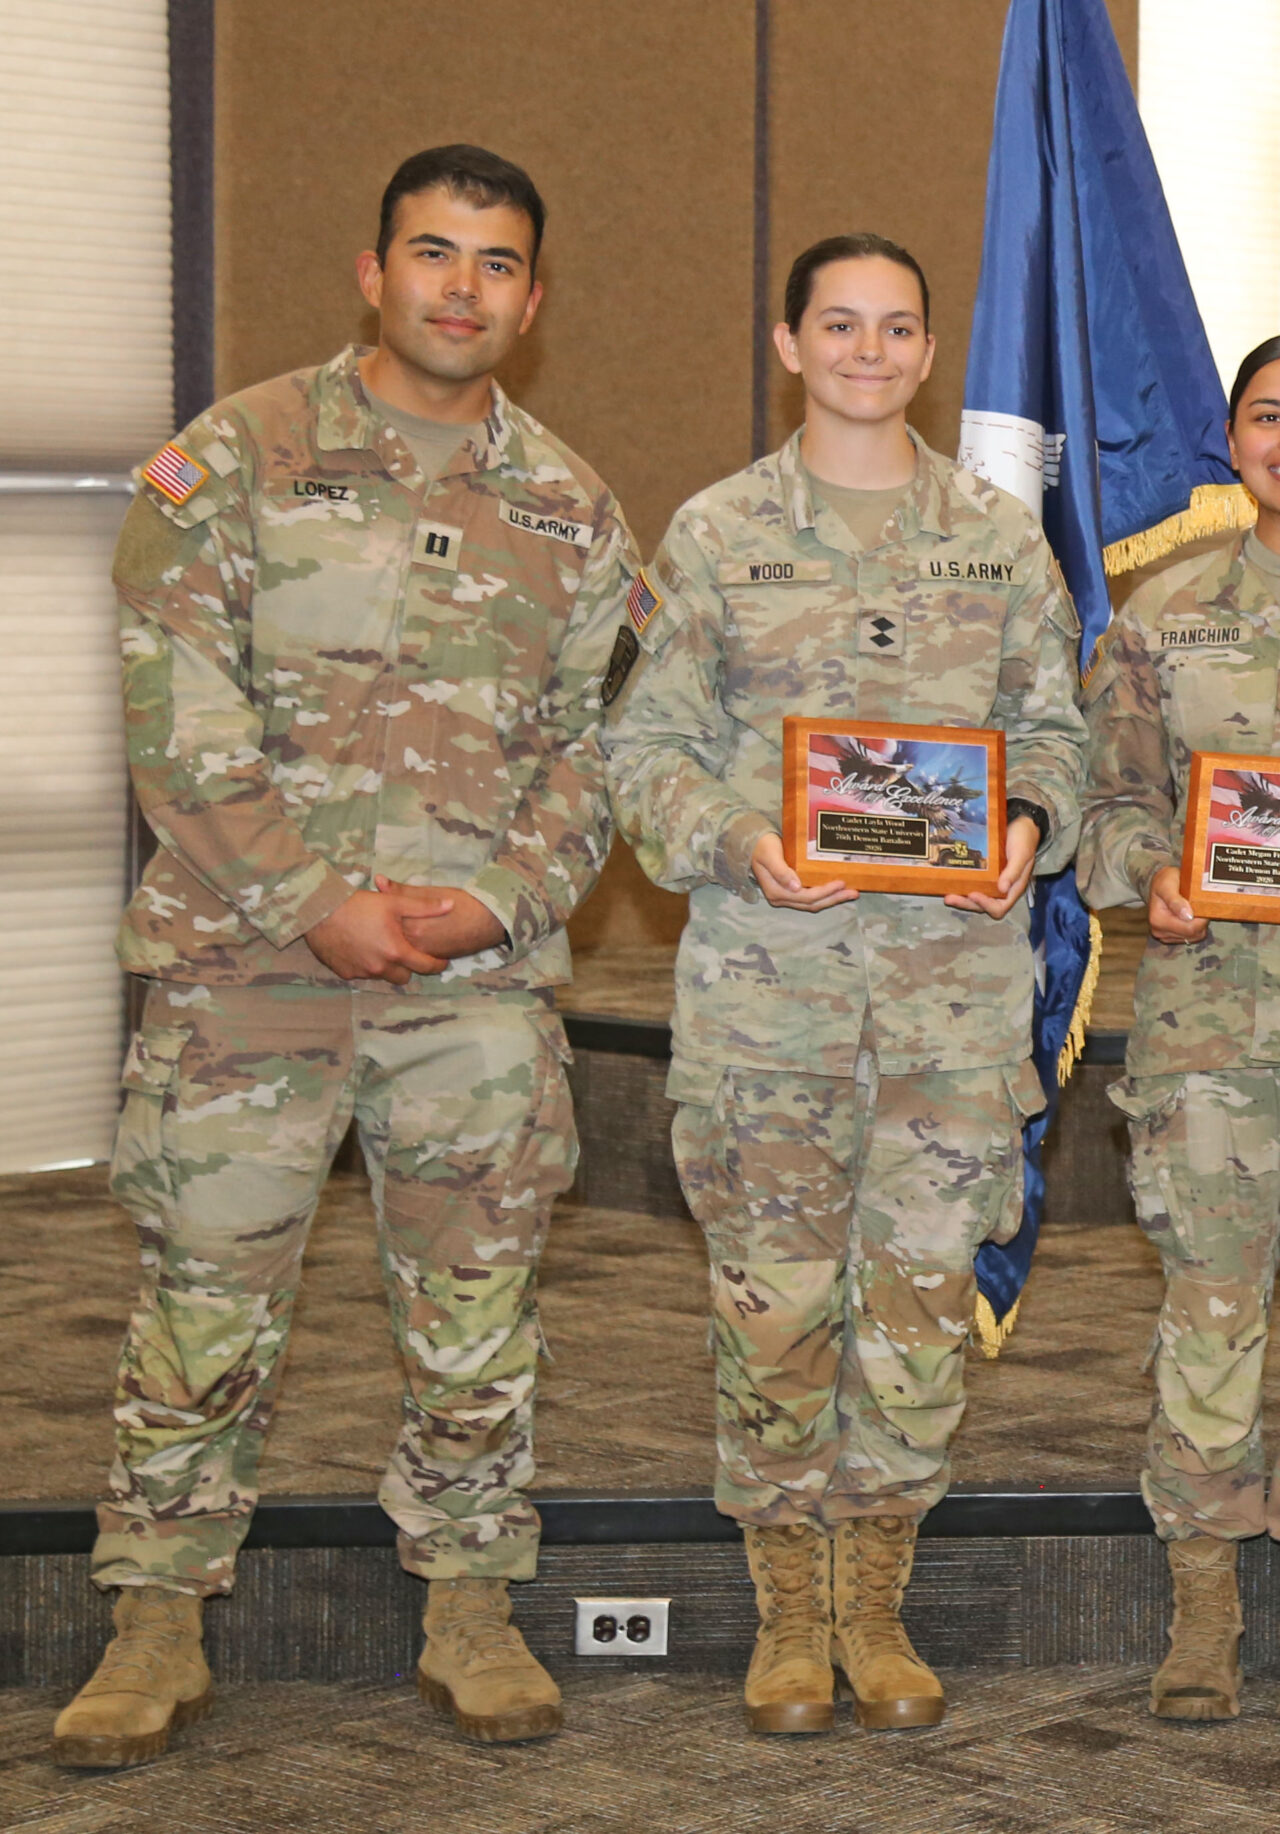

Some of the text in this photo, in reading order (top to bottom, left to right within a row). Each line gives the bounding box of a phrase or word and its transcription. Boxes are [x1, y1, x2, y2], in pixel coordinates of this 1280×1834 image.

[294, 480, 349, 500] LOPEZ
[749, 563, 794, 581] WOOD
[1161, 627, 1240, 647] FRANCHINO
[823, 772, 888, 795] Award
[882, 785, 964, 811] Excellence
[842, 816, 862, 824] Cadet
[822, 824, 869, 833] Northwestern
[890, 829, 924, 837] University
[880, 837, 911, 845] Battalion
[1248, 849, 1271, 858] Megan
[1216, 856, 1262, 865] Northwestern
[1245, 867, 1271, 875] Demon
